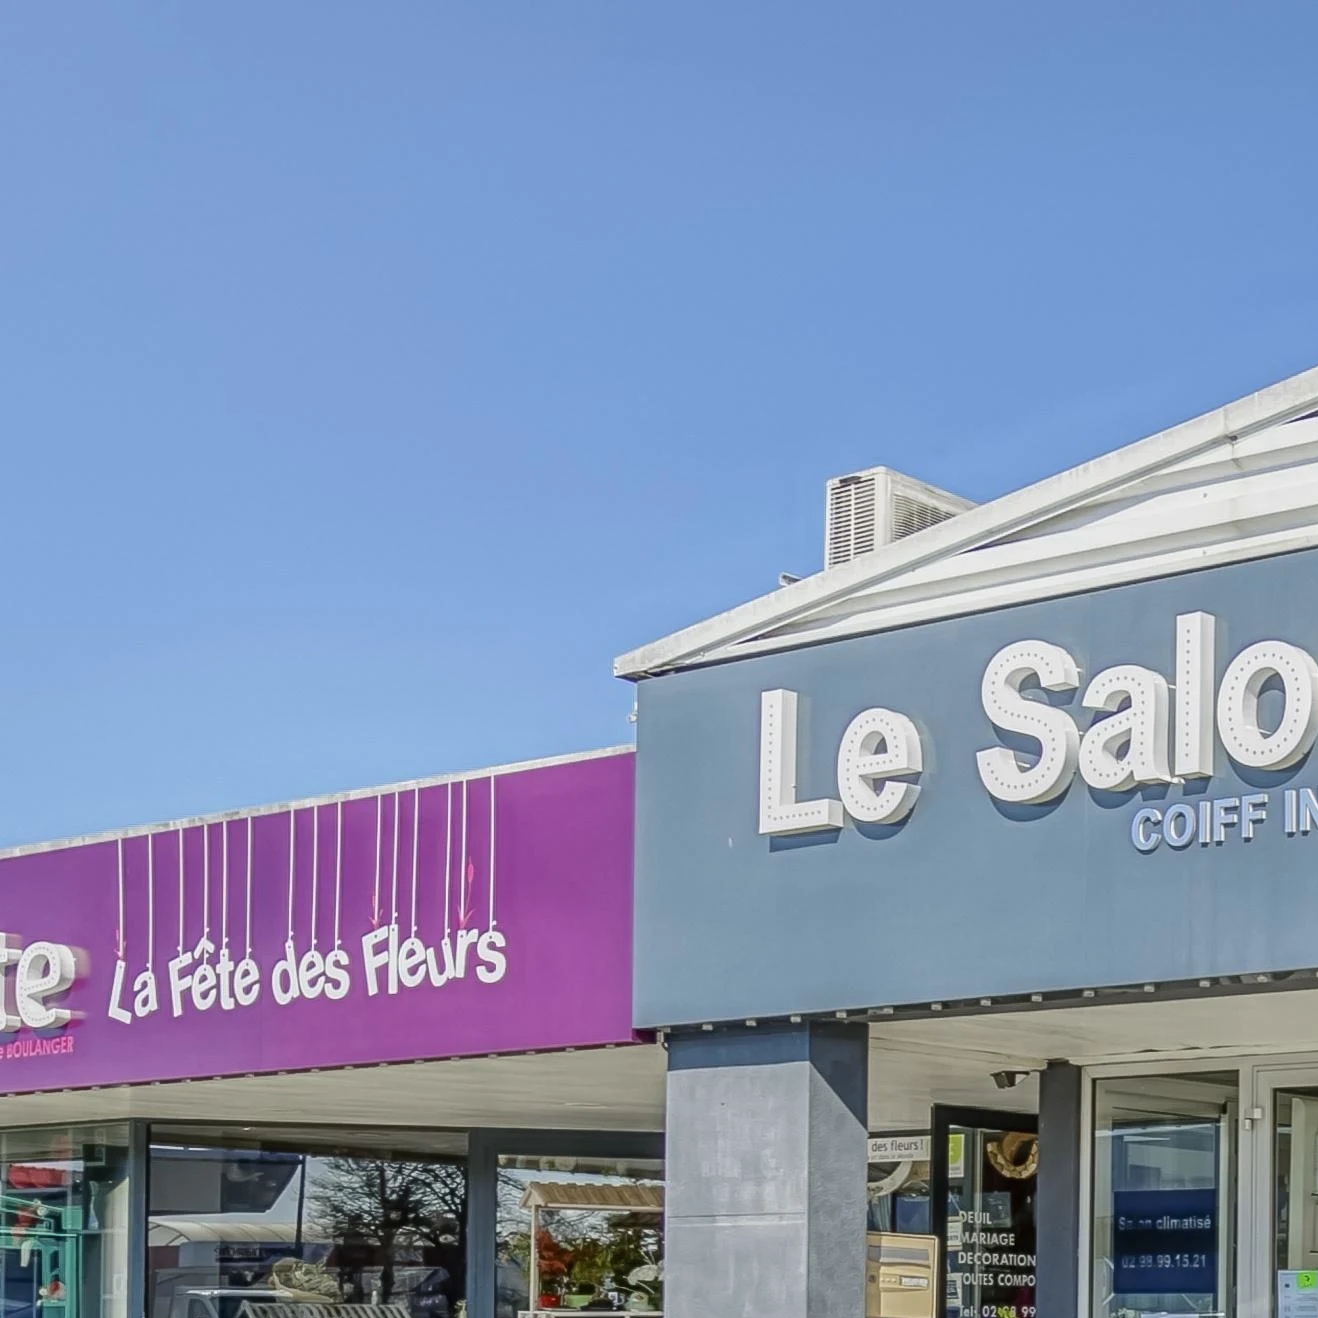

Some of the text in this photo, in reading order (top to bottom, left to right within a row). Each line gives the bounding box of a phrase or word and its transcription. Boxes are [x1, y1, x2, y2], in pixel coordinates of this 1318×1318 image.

[758, 688, 924, 836] Le
[1131, 793, 1268, 852] COIFF
[108, 923, 507, 1024] La Fête des Fleurs
[6, 1036, 74, 1059] BOULANGER
[872, 1140, 888, 1152] des
[959, 1210, 992, 1225] DEUIL
[1119, 1214, 1211, 1230] Saon climatisé
[960, 1231, 1015, 1246] MARIAGE
[958, 1251, 1036, 1267] DECORATION
[960, 1272, 1036, 1287] TOUTES COMPO
[982, 1305, 996, 1318] 02
[1021, 1306, 1036, 1318] 99
